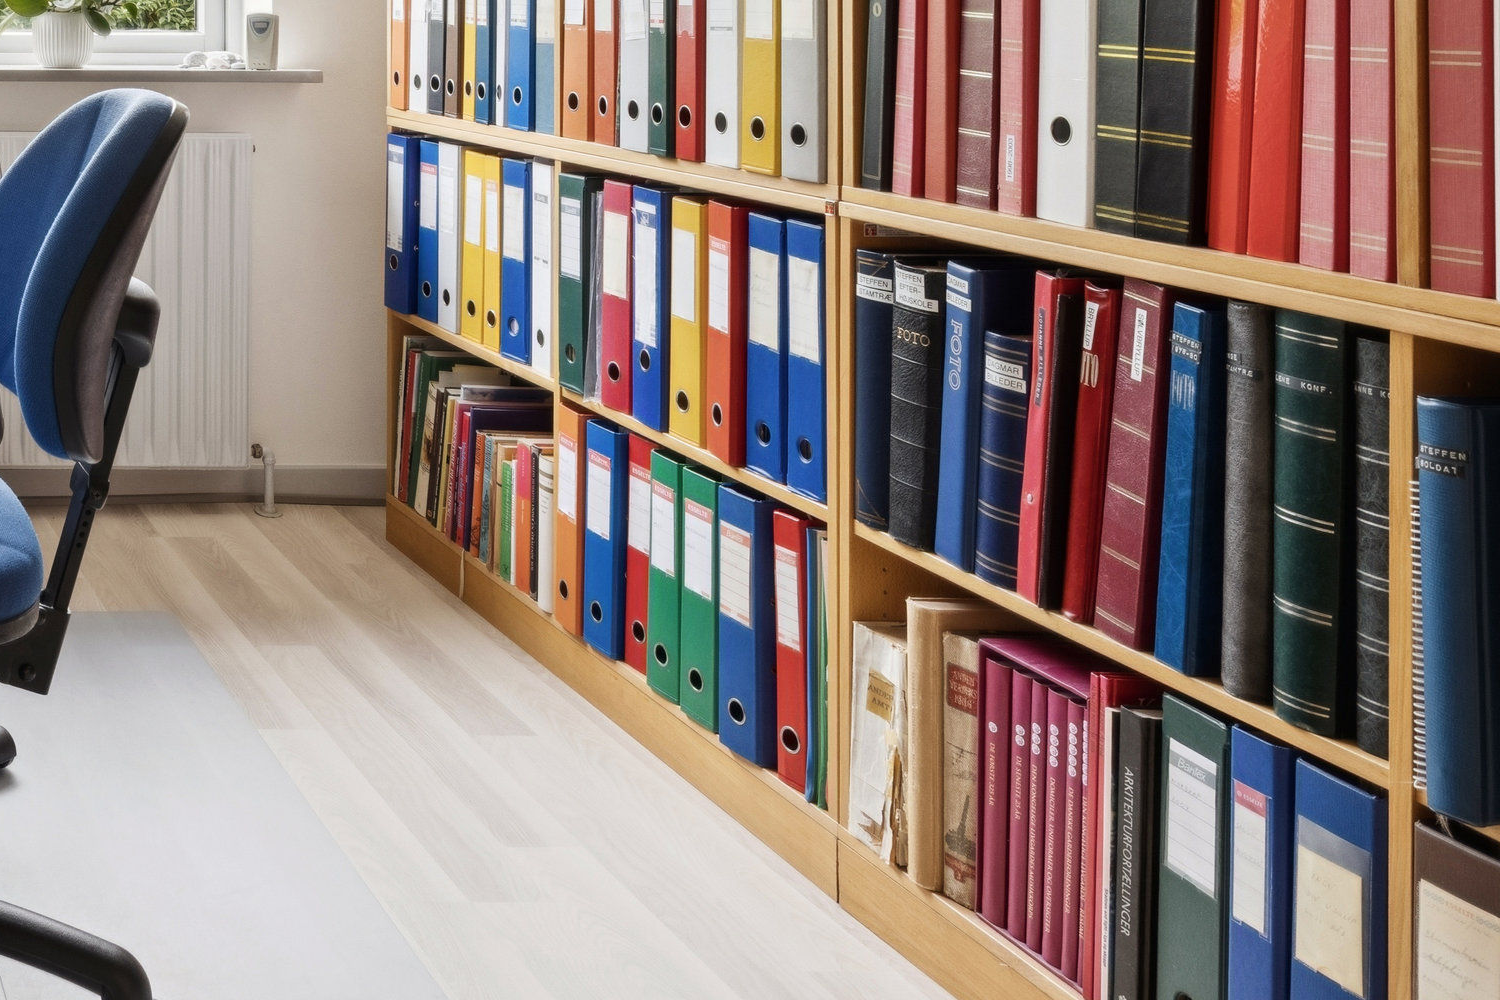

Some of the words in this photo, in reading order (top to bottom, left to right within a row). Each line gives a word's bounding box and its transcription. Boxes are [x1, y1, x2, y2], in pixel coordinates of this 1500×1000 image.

[859, 276, 889, 288] STEFFEN
[896, 270, 922, 284] STEFFEN
[947, 276, 967, 290] DAGMAR
[859, 288, 892, 301] STAMTRÆ
[900, 283, 922, 295] EFTER-
[898, 294, 933, 309] HØJSKOLE
[947, 292, 968, 307] BILLEDER
[1085, 307, 1095, 347] BRYLLUP
[897, 326, 931, 347] FOTO
[1172, 333, 1200, 350] STEFFEN
[948, 319, 963, 391] FOTO
[986, 359, 1021, 376] DAGMAR
[1080, 350, 1099, 388] TO
[1227, 364, 1254, 378] TAMTRÆ
[986, 372, 1023, 391] BILLEDER
[1275, 373, 1291, 385] LENE
[1300, 381, 1333, 395] KONF.
[1171, 369, 1196, 412] FOTO
[1420, 444, 1467, 461] STEFFEN
[631, 466, 651, 481] ESSELTE
[1420, 459, 1458, 475] SOLDAT
[654, 484, 672, 499] ESSELTE
[687, 503, 708, 519] ESSELTE
[989, 742, 996, 753] DE
[1015, 755, 1022, 766] DE
[1177, 758, 1206, 782] Bantex
[1068, 787, 1075, 798] DE
[988, 796, 995, 806] ÅR
[1015, 799, 1021, 808] 25
[1015, 809, 1022, 820] ÅR
[1120, 766, 1134, 937] ARKITEKTURFORTÆLLINGER
[1046, 872, 1053, 884] OG
[1065, 832, 1073, 914] GARDERFORENINGER
[1044, 885, 1052, 933] OVERSIGTER
